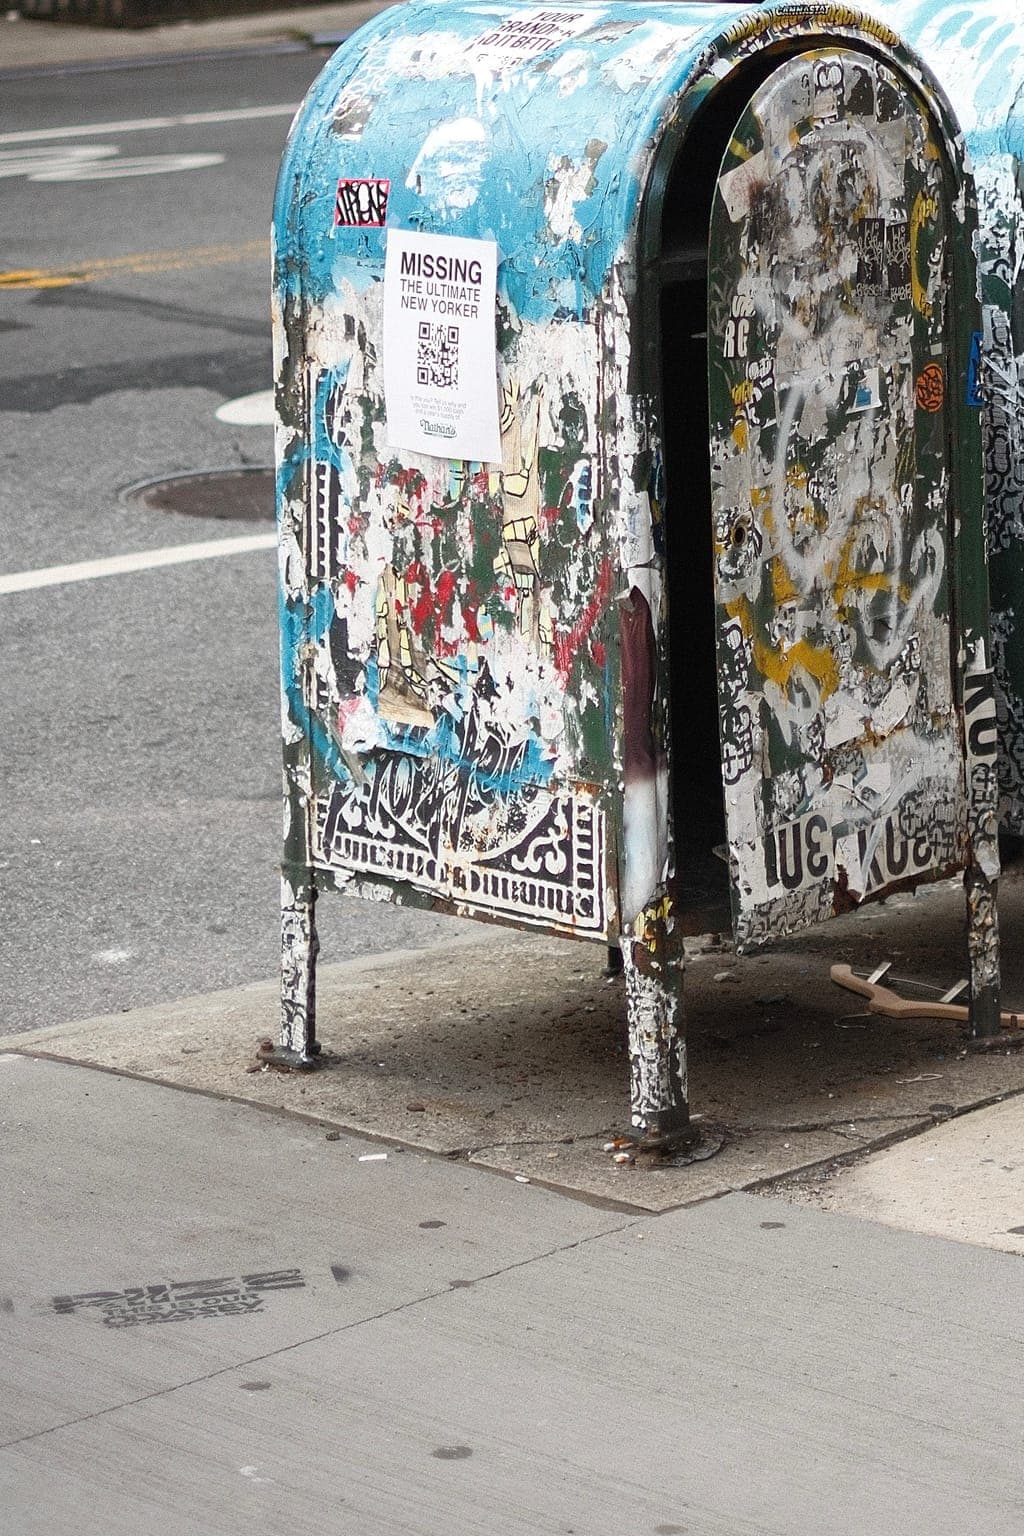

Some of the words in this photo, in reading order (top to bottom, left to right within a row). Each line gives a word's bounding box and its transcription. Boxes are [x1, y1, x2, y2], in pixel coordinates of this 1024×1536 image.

[531, 11, 585, 23] YOUR
[401, 251, 482, 285] MISSING
[400, 278, 423, 294] THE
[426, 282, 481, 303] ULTIMATE
[401, 295, 428, 312] NEW
[431, 299, 479, 320] YORKER
[202, 1293, 260, 1306] OUR
